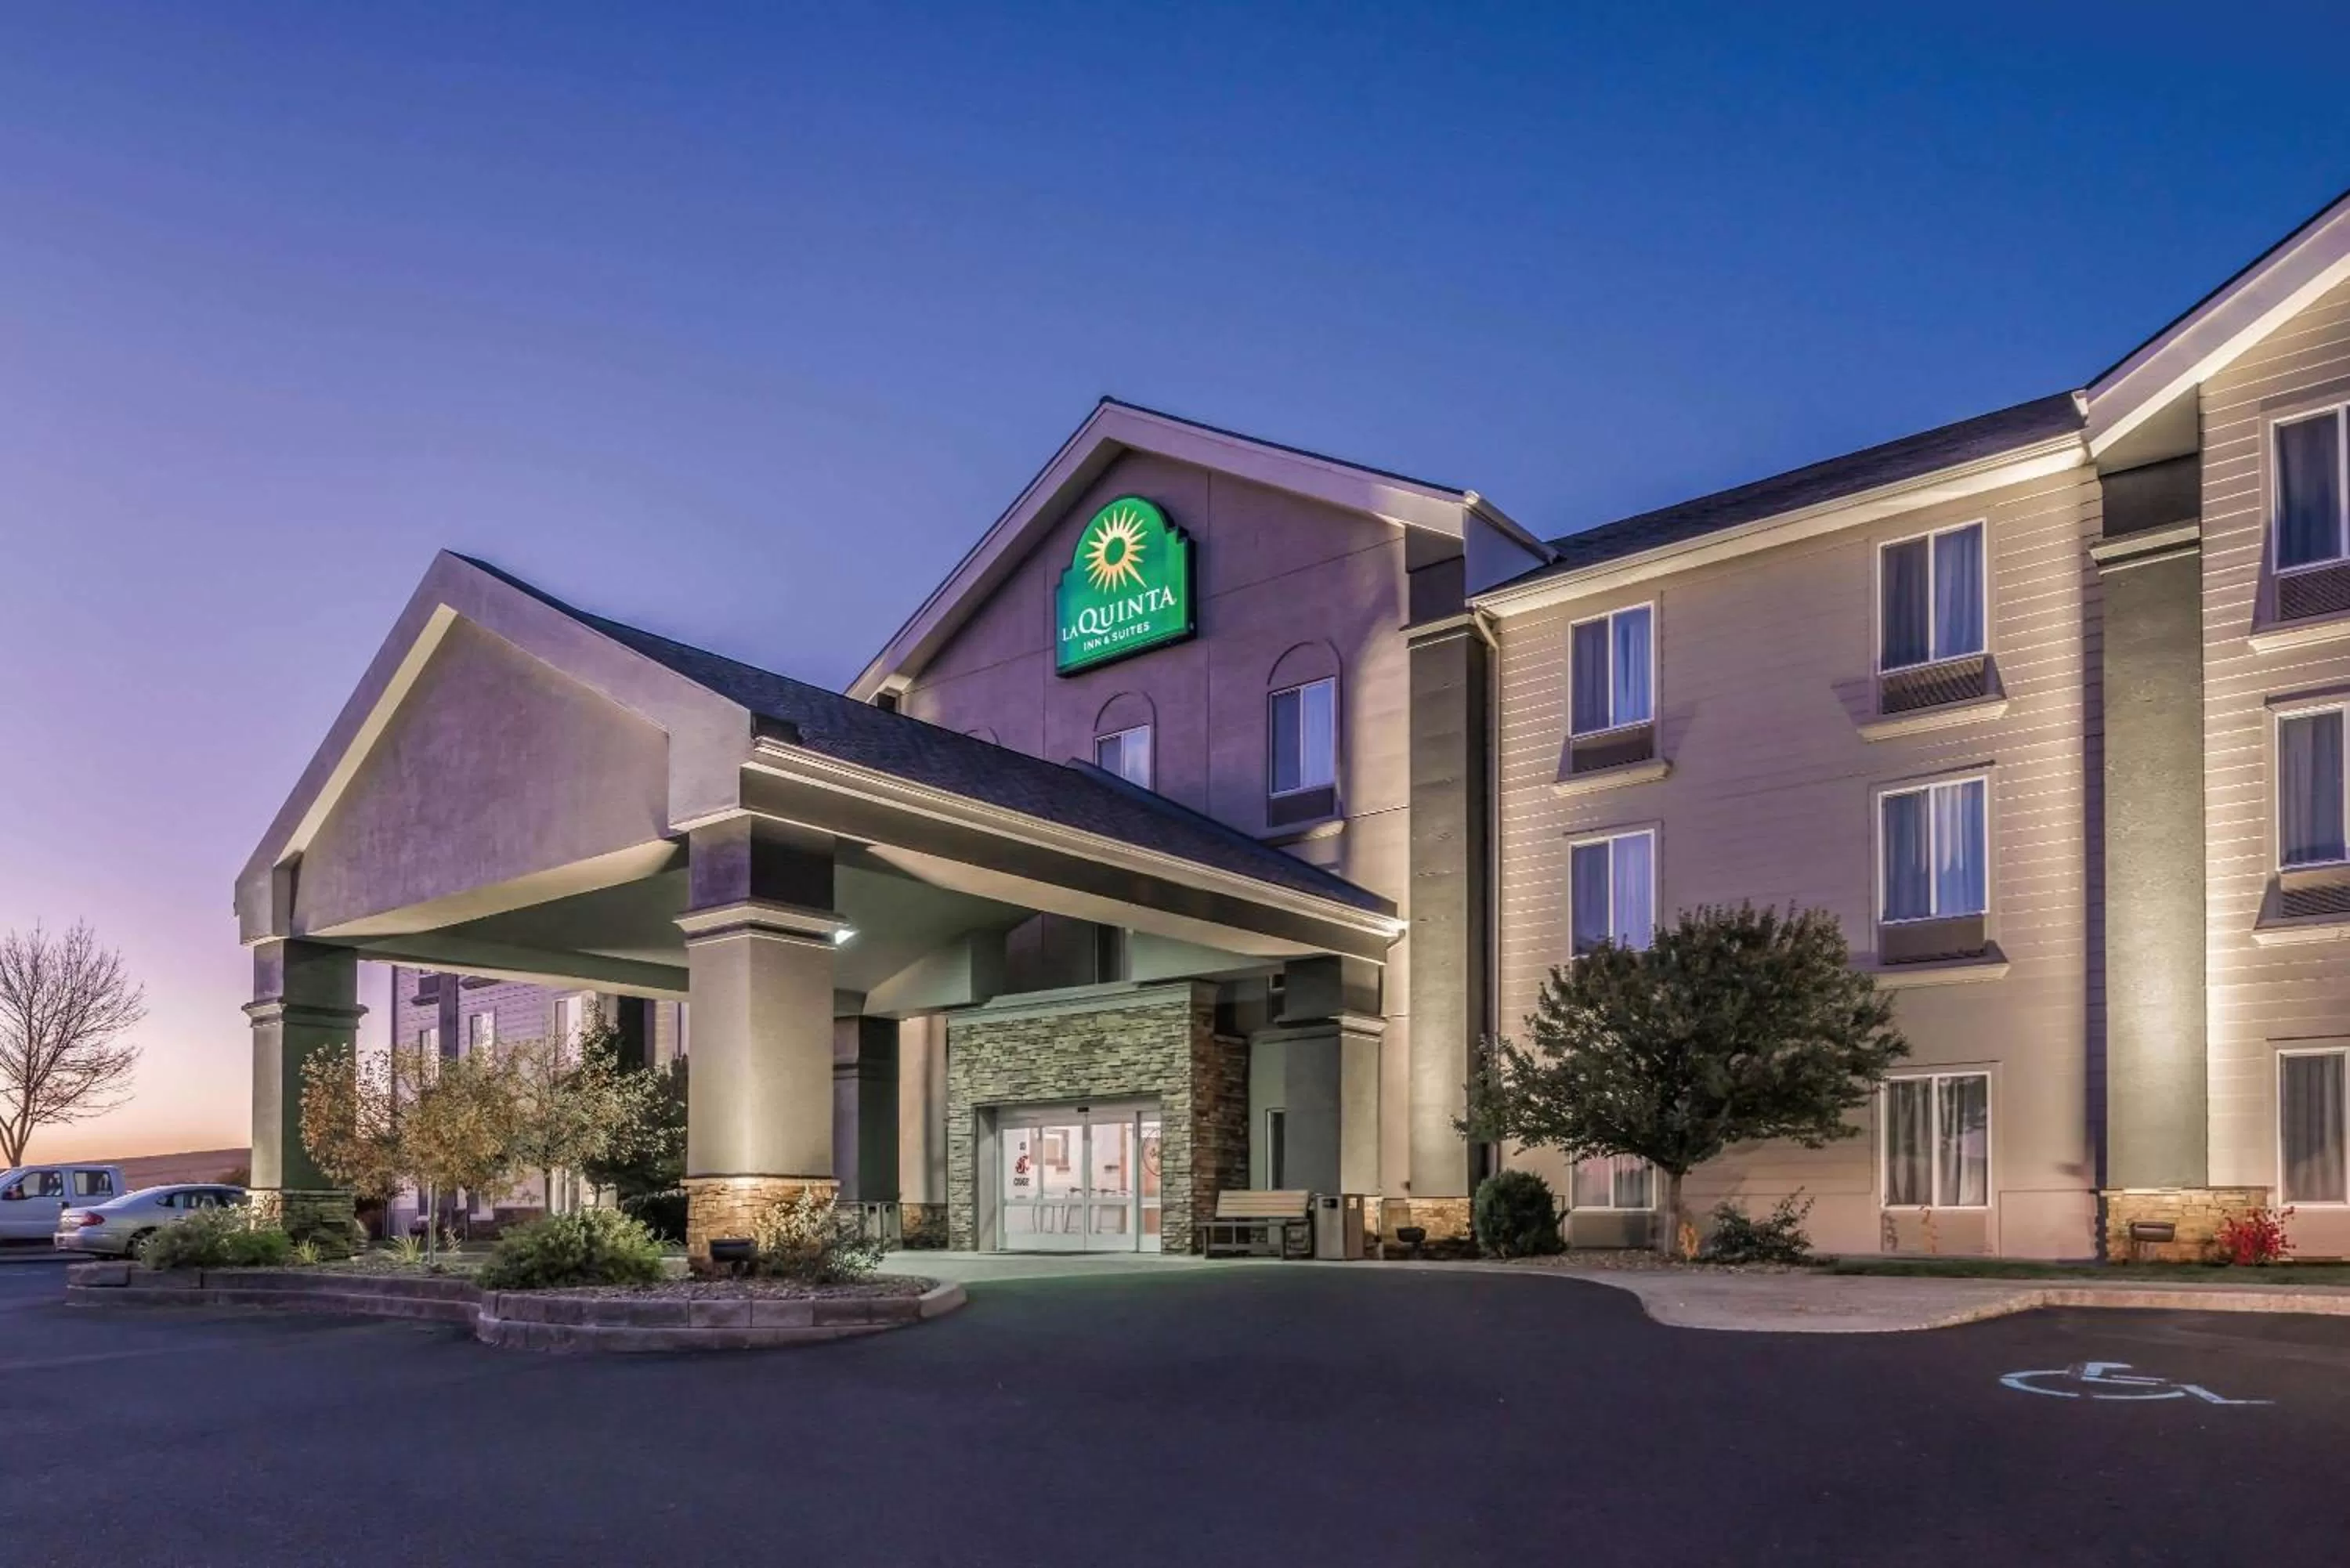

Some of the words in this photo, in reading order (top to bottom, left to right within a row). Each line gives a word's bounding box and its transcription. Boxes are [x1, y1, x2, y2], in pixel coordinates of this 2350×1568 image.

[1062, 625, 1078, 641] LA
[1078, 585, 1176, 634] QUINTA
[1083, 636, 1101, 652] INN
[1104, 635, 1110, 645] &
[1112, 621, 1151, 641] SUITES
